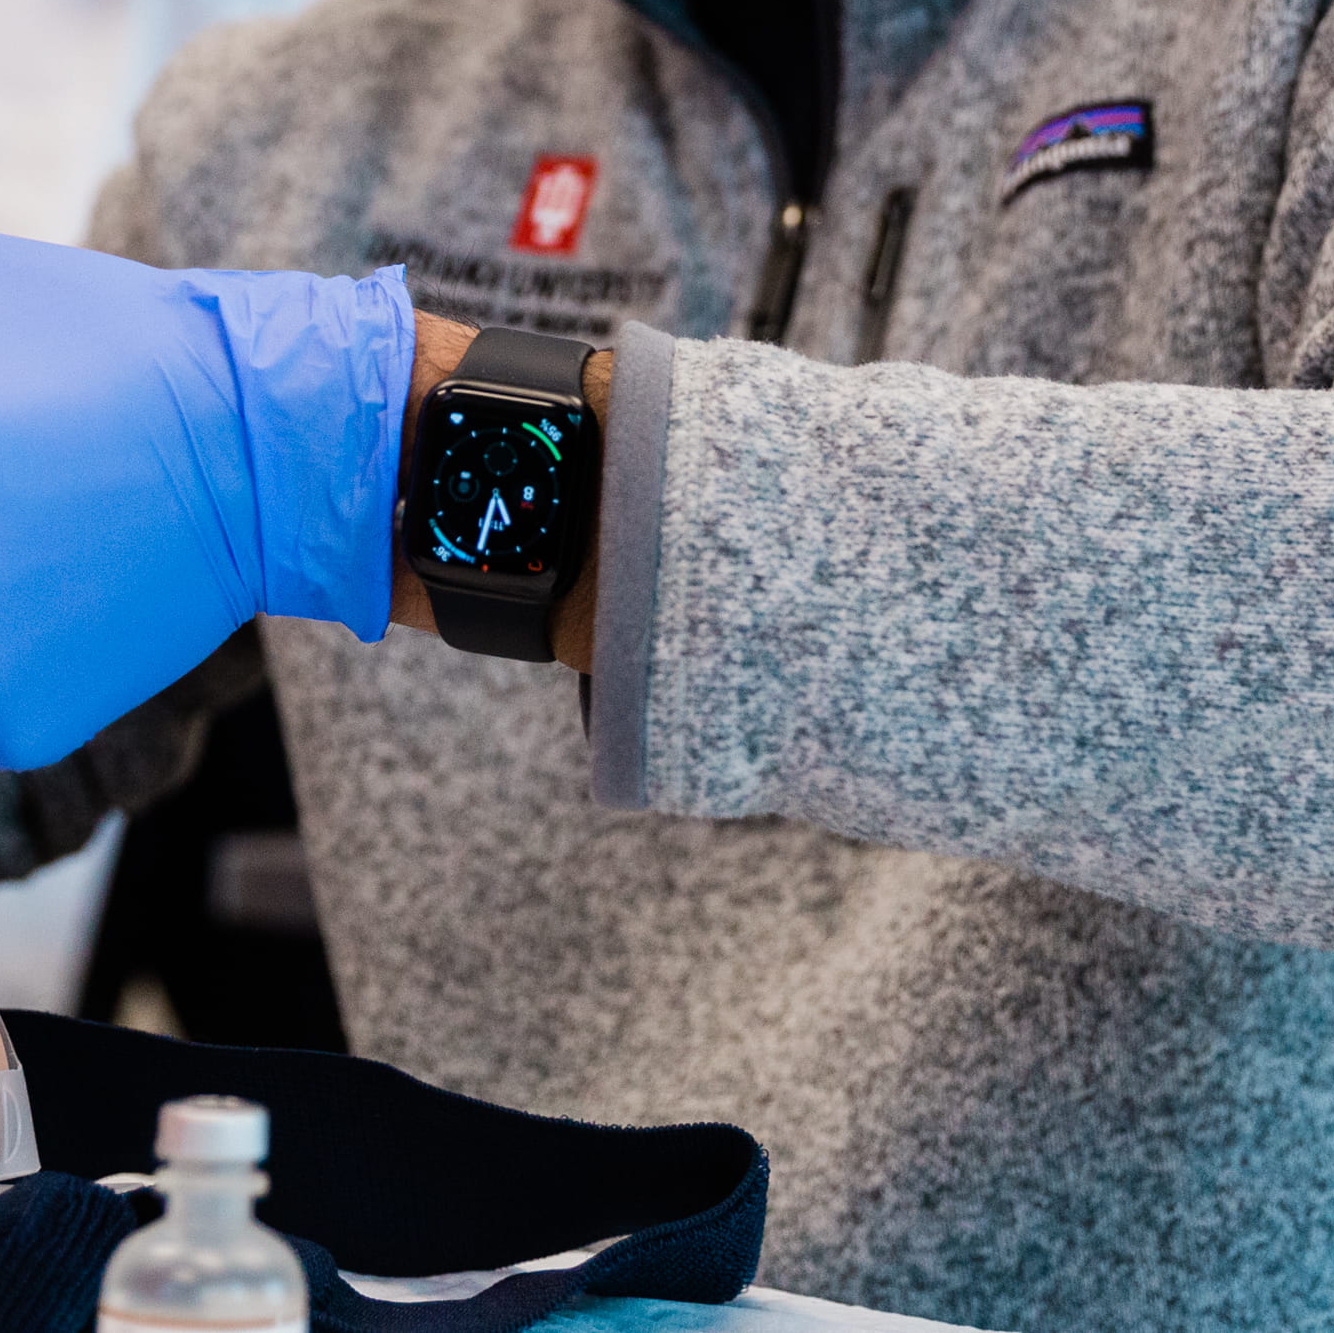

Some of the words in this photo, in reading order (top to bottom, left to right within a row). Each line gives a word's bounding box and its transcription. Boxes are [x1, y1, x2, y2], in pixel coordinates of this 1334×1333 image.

[539, 418, 563, 443] 95%
[523, 486, 535, 501] 8
[478, 517, 505, 532] 11:1
